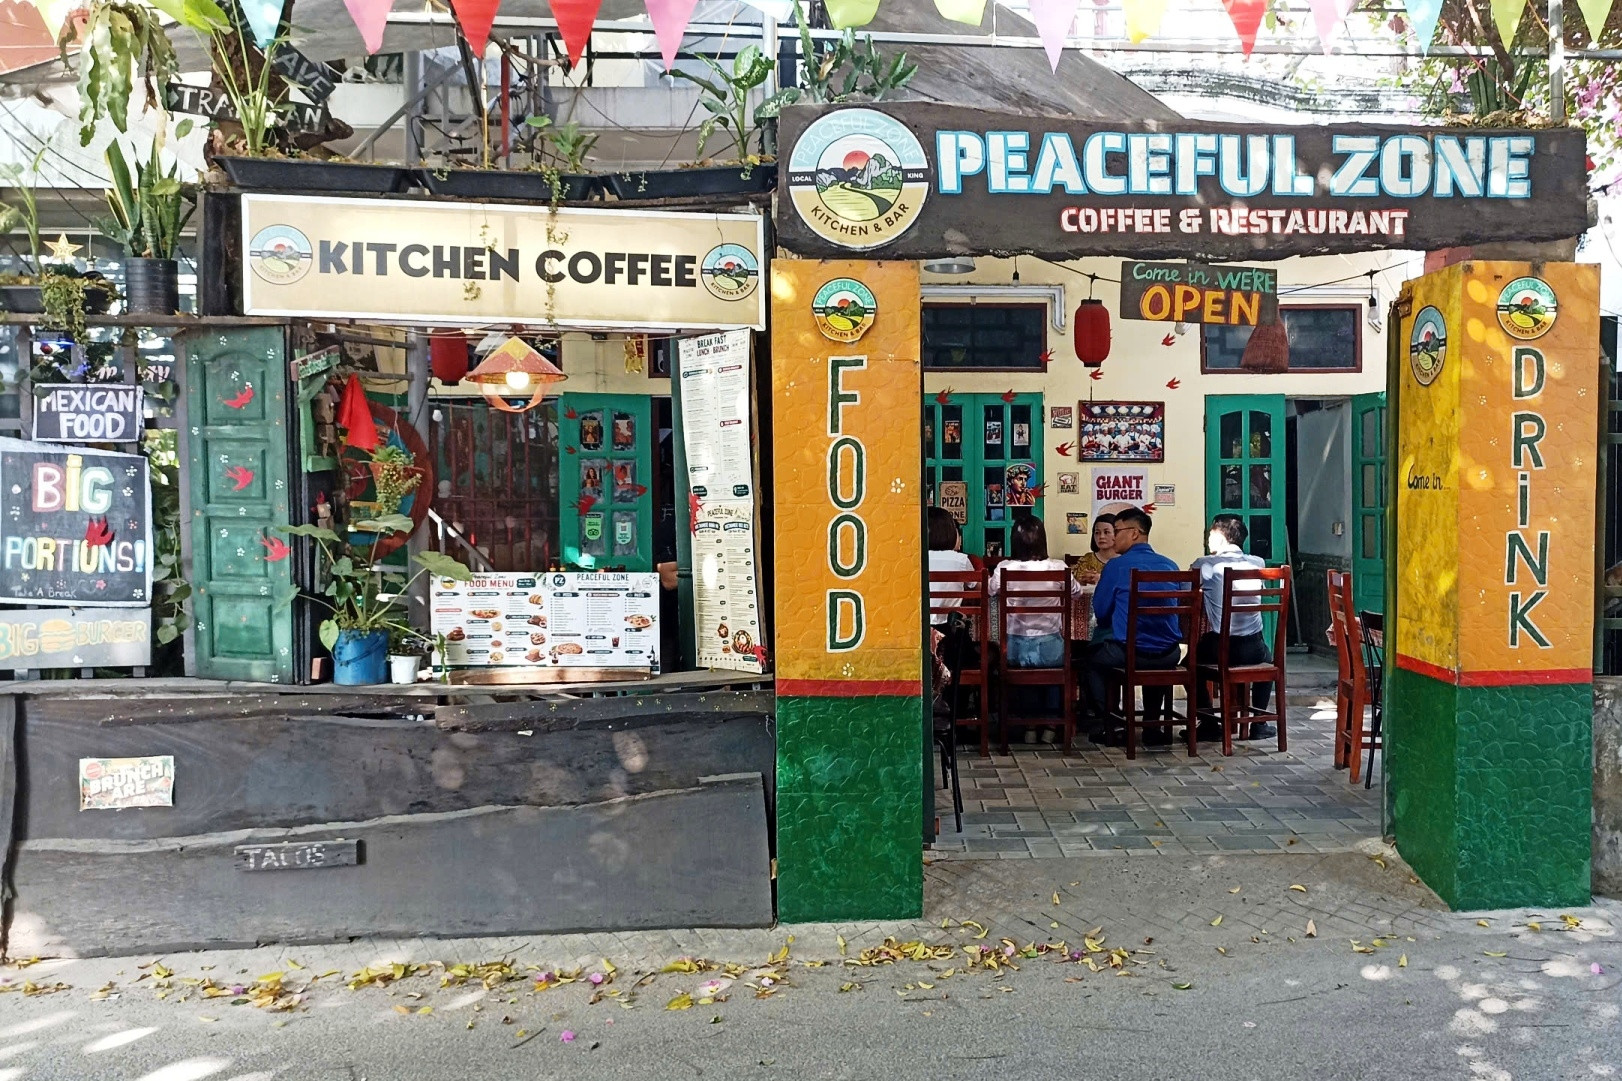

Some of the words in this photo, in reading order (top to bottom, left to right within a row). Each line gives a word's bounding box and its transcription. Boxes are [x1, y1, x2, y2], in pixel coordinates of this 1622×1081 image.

[796, 115, 870, 164] PEACEFUL
[875, 120, 919, 161] ZONE
[936, 130, 1314, 197] PEACEFUL
[1330, 134, 1535, 198] ZONE
[811, 205, 868, 236] KITCHEN
[874, 222, 882, 232] &
[885, 203, 909, 227] BAR
[1061, 207, 1171, 233] COFFEE
[1179, 208, 1202, 234] &
[1210, 208, 1409, 235] RESTAURANT
[320, 240, 520, 283] KITCHEN
[535, 250, 697, 287] COFFEE
[1133, 263, 1181, 281] Come
[1188, 267, 1210, 286] in
[711, 282, 734, 295] KITCHEN
[816, 280, 850, 304] PEACEFUL
[853, 282, 873, 304] ZONE
[1140, 284, 1260, 327] OPEN
[822, 322, 849, 337] KITCHEN
[1506, 320, 1530, 334] KITCHEN
[40, 389, 134, 412] MEXICAN
[60, 412, 125, 438] FOOD
[1096, 475, 1143, 489] GIANT
[1408, 464, 1430, 489] Come
[827, 355, 868, 653] FOOD
[941, 496, 965, 507] PIZZA
[1096, 489, 1143, 500] BURGER
[5, 535, 145, 574] PORTIONS!
[464, 579, 486, 587] FOOD
[577, 573, 610, 581] PEACEFUL
[612, 573, 629, 581] ZONE
[76, 620, 147, 646] BURGER
